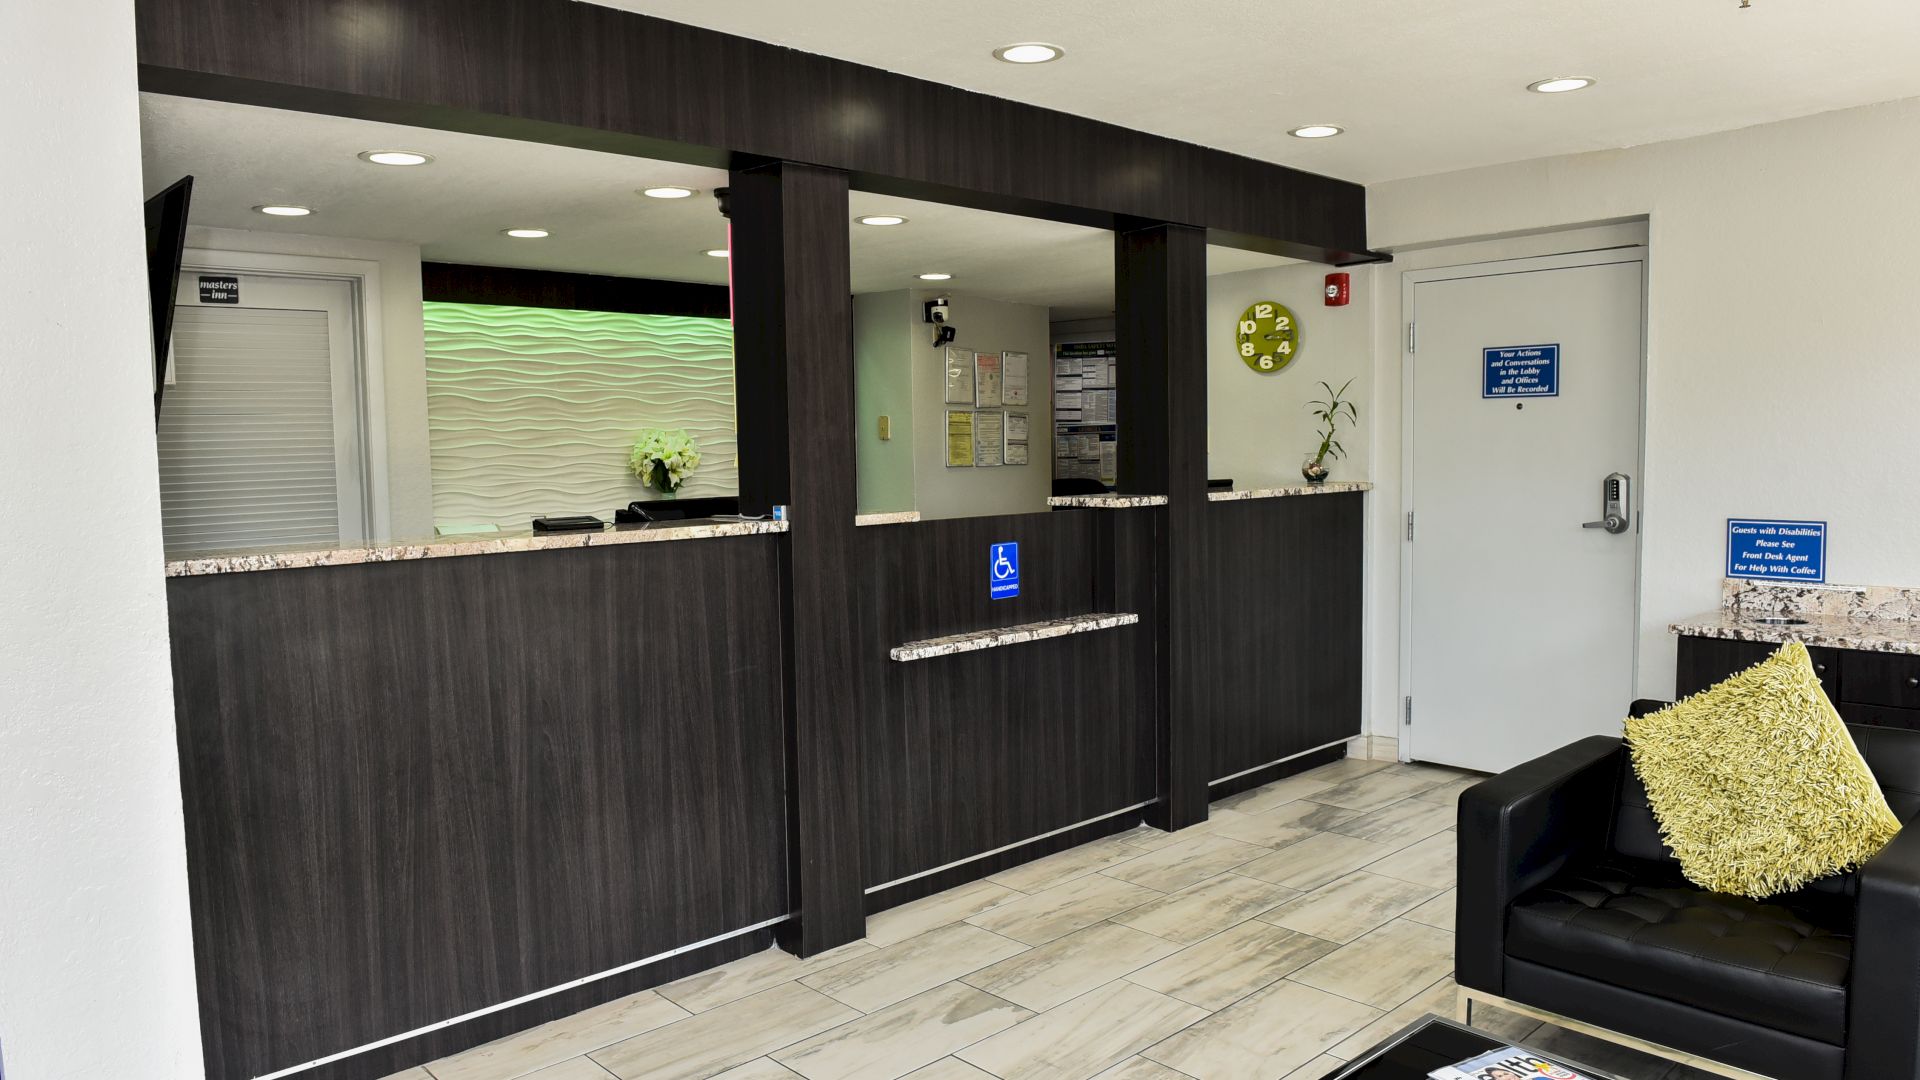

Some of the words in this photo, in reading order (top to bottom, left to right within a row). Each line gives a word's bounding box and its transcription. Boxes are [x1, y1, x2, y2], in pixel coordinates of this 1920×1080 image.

[200, 281, 238, 290] masters
[211, 290, 228, 299] inn
[1255, 304, 1273, 318] 12
[1240, 320, 1257, 334] 10
[1275, 316, 1290, 331] 2
[1241, 342, 1255, 356] 8
[1277, 340, 1292, 354] 4
[1259, 355, 1274, 369] 6
[1504, 358, 1550, 366] Conversations
[1520, 367, 1541, 376] Lobby
[1515, 376, 1539, 384] Offices
[1517, 385, 1549, 393] Recorded
[1732, 526, 1757, 534] Guests
[1778, 528, 1821, 536] Disabilities
[1755, 539, 1779, 548] Please
[1781, 540, 1796, 548] See
[1742, 551, 1762, 559] Front
[1764, 552, 1783, 560] Desk
[1785, 553, 1809, 563] Agent
[1734, 563, 1747, 571] For
[1749, 564, 1767, 573] Help
[1769, 565, 1788, 573] With
[1790, 566, 1817, 575] Coffee
